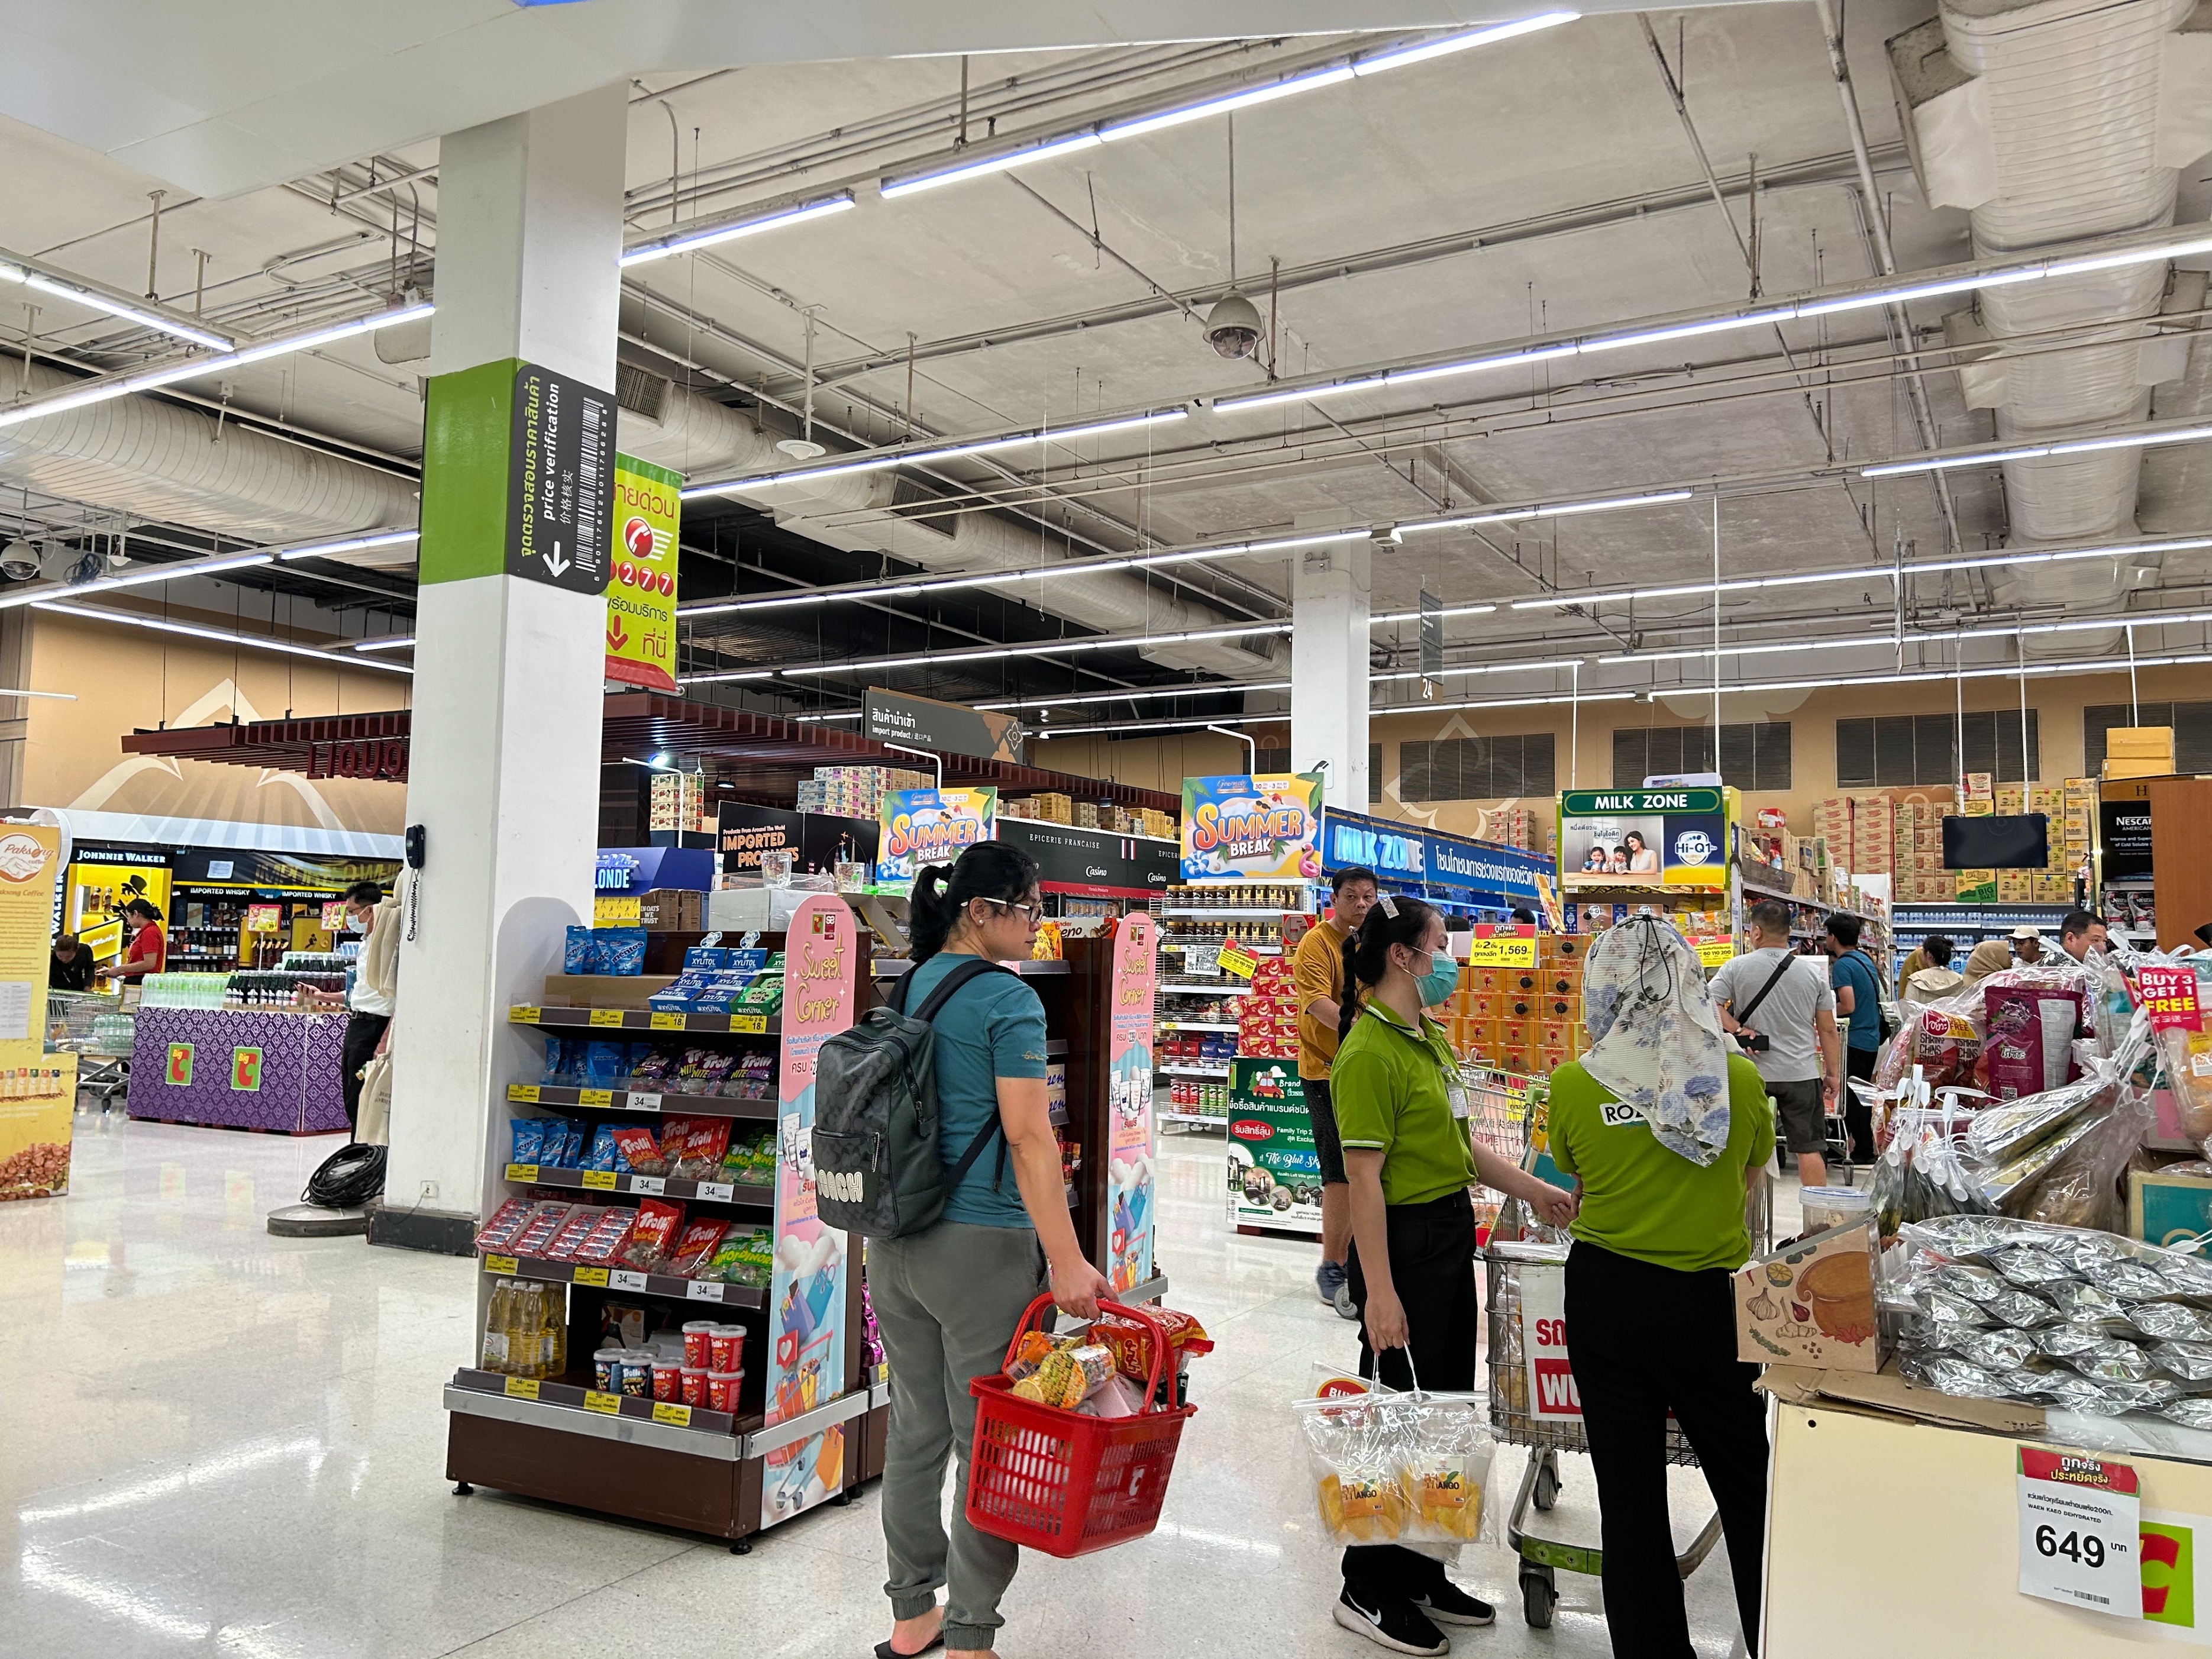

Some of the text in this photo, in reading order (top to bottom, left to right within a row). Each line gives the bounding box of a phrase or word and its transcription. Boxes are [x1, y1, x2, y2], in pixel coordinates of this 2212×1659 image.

[541, 383, 559, 521] price verification
[522, 376, 540, 557] จุดตรวจสอบราคาสินค้า
[560, 470, 573, 525] 价格核实
[642, 627, 667, 659] ที่นี่
[1422, 678, 1433, 701] 24
[872, 708, 916, 728] สินค้านำเข้า
[872, 725, 911, 740] import product
[1596, 794, 1688, 809] MILK ZONE
[1196, 803, 1302, 850] SUMMER
[722, 832, 786, 851] IMPORTED
[890, 814, 977, 856] SUMMER
[1029, 834, 1100, 849] EPICERIE FRANCAISE
[917, 845, 952, 862] BREAK
[1230, 838, 1272, 857] BREAK
[1334, 825, 1423, 873] MILK ZONE
[1675, 843, 1711, 853] Hi-Q1
[77, 850, 166, 863] JOHNNIE WALKER
[1086, 866, 1107, 877] Casino
[1148, 872, 1167, 883] Casino
[1978, 886, 1994, 895] BIG
[611, 941, 644, 965] mentos
[800, 932, 845, 980] Sweet
[1122, 940, 1150, 975] Sweet
[1499, 945, 1528, 956] 1,569
[2142, 973, 2193, 986] BUY 3
[1118, 976, 1146, 1006] Corner
[2143, 986, 2192, 998] GET 1
[795, 982, 839, 1023] Corner
[2143, 997, 2196, 1013] FREE
[752, 1022, 761, 1031] 18
[1950, 1023, 1969, 1032] FREE
[2151, 1015, 2192, 1025] 买三送一
[172, 1049, 183, 1060] Big
[238, 1053, 250, 1064] Big
[692, 1069, 708, 1079] NITE
[732, 1069, 749, 1079] NITE
[792, 1061, 807, 1074] ครบ
[1278, 1079, 1301, 1087] Brand
[634, 1097, 644, 1106] 34
[1229, 1098, 1309, 1114] มื่อซื้อสินค้าแบรนด์ชนิ
[687, 1128, 714, 1148] Trolli
[1277, 1127, 1295, 1135] Family
[621, 1137, 651, 1154] Trolli
[1265, 1152, 1304, 1168] The Blue
[639, 1180, 650, 1189] 34
[705, 1186, 715, 1195] 34
[688, 1226, 719, 1243] Trolli
[618, 1274, 628, 1283] 34
[697, 1285, 707, 1295] 34
[2061, 1457, 2101, 1471] ถูกจริง
[2050, 1469, 2108, 1484] ประหยัดจริง
[2028, 1503, 2101, 1524] WAEN KAEO DEHYDRATED
[2036, 1524, 2127, 1568] 649 บาท
